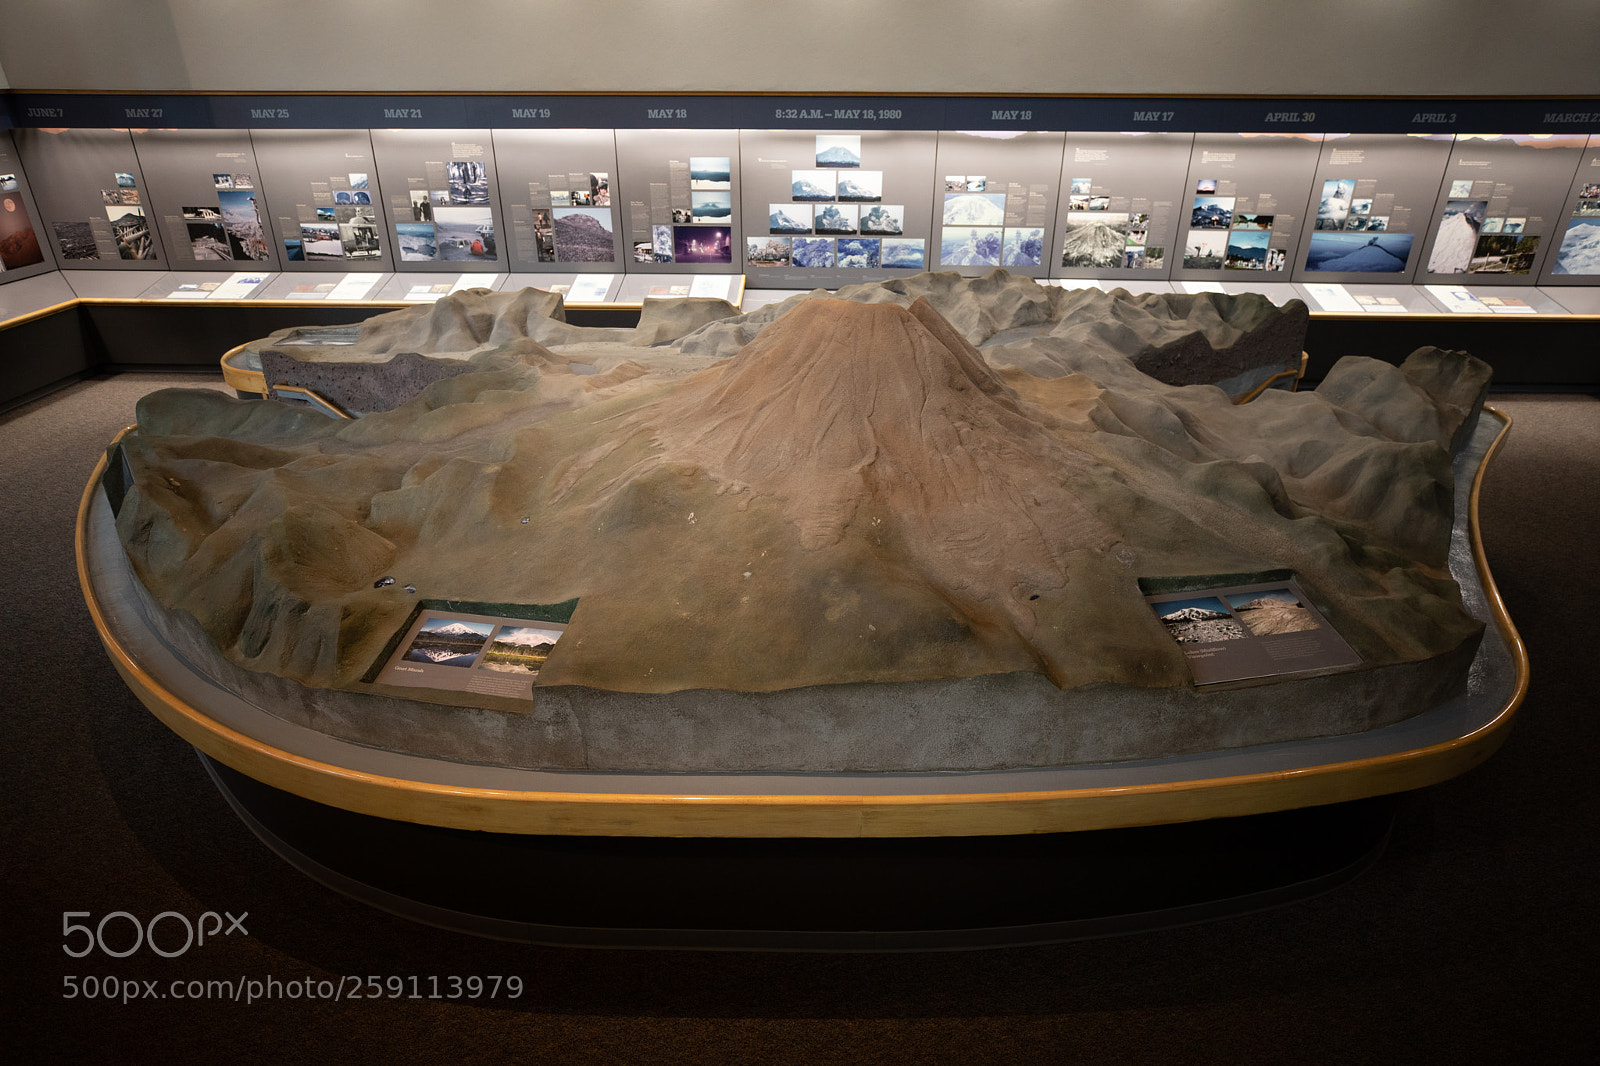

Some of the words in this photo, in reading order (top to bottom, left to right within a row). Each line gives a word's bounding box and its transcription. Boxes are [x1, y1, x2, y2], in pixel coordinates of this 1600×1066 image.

[27, 108, 57, 118] JUNE
[57, 108, 64, 118] 7
[124, 108, 149, 118] MAY
[150, 108, 163, 118] 27
[250, 109, 276, 119] MAY
[276, 109, 290, 118] 25
[383, 108, 410, 118] MAY
[410, 108, 422, 118] 21
[512, 108, 539, 118] MAY
[540, 108, 551, 118] 19
[647, 109, 674, 118] MAY
[675, 109, 687, 118] 18
[775, 109, 798, 119] 8:32
[799, 110, 824, 119] A.M.
[834, 109, 861, 119] MAY
[862, 109, 877, 121] 18,
[879, 109, 902, 119] 1980
[991, 110, 1020, 120] MAY
[1020, 110, 1032, 120] 18
[1133, 111, 1162, 121] MAY
[1162, 111, 1174, 121] 17
[1264, 112, 1300, 122] APRIL
[1301, 112, 1315, 122] 30
[1411, 112, 1448, 123] APRIL
[1448, 113, 1457, 123] 3
[1543, 112, 1591, 123] MARCH
